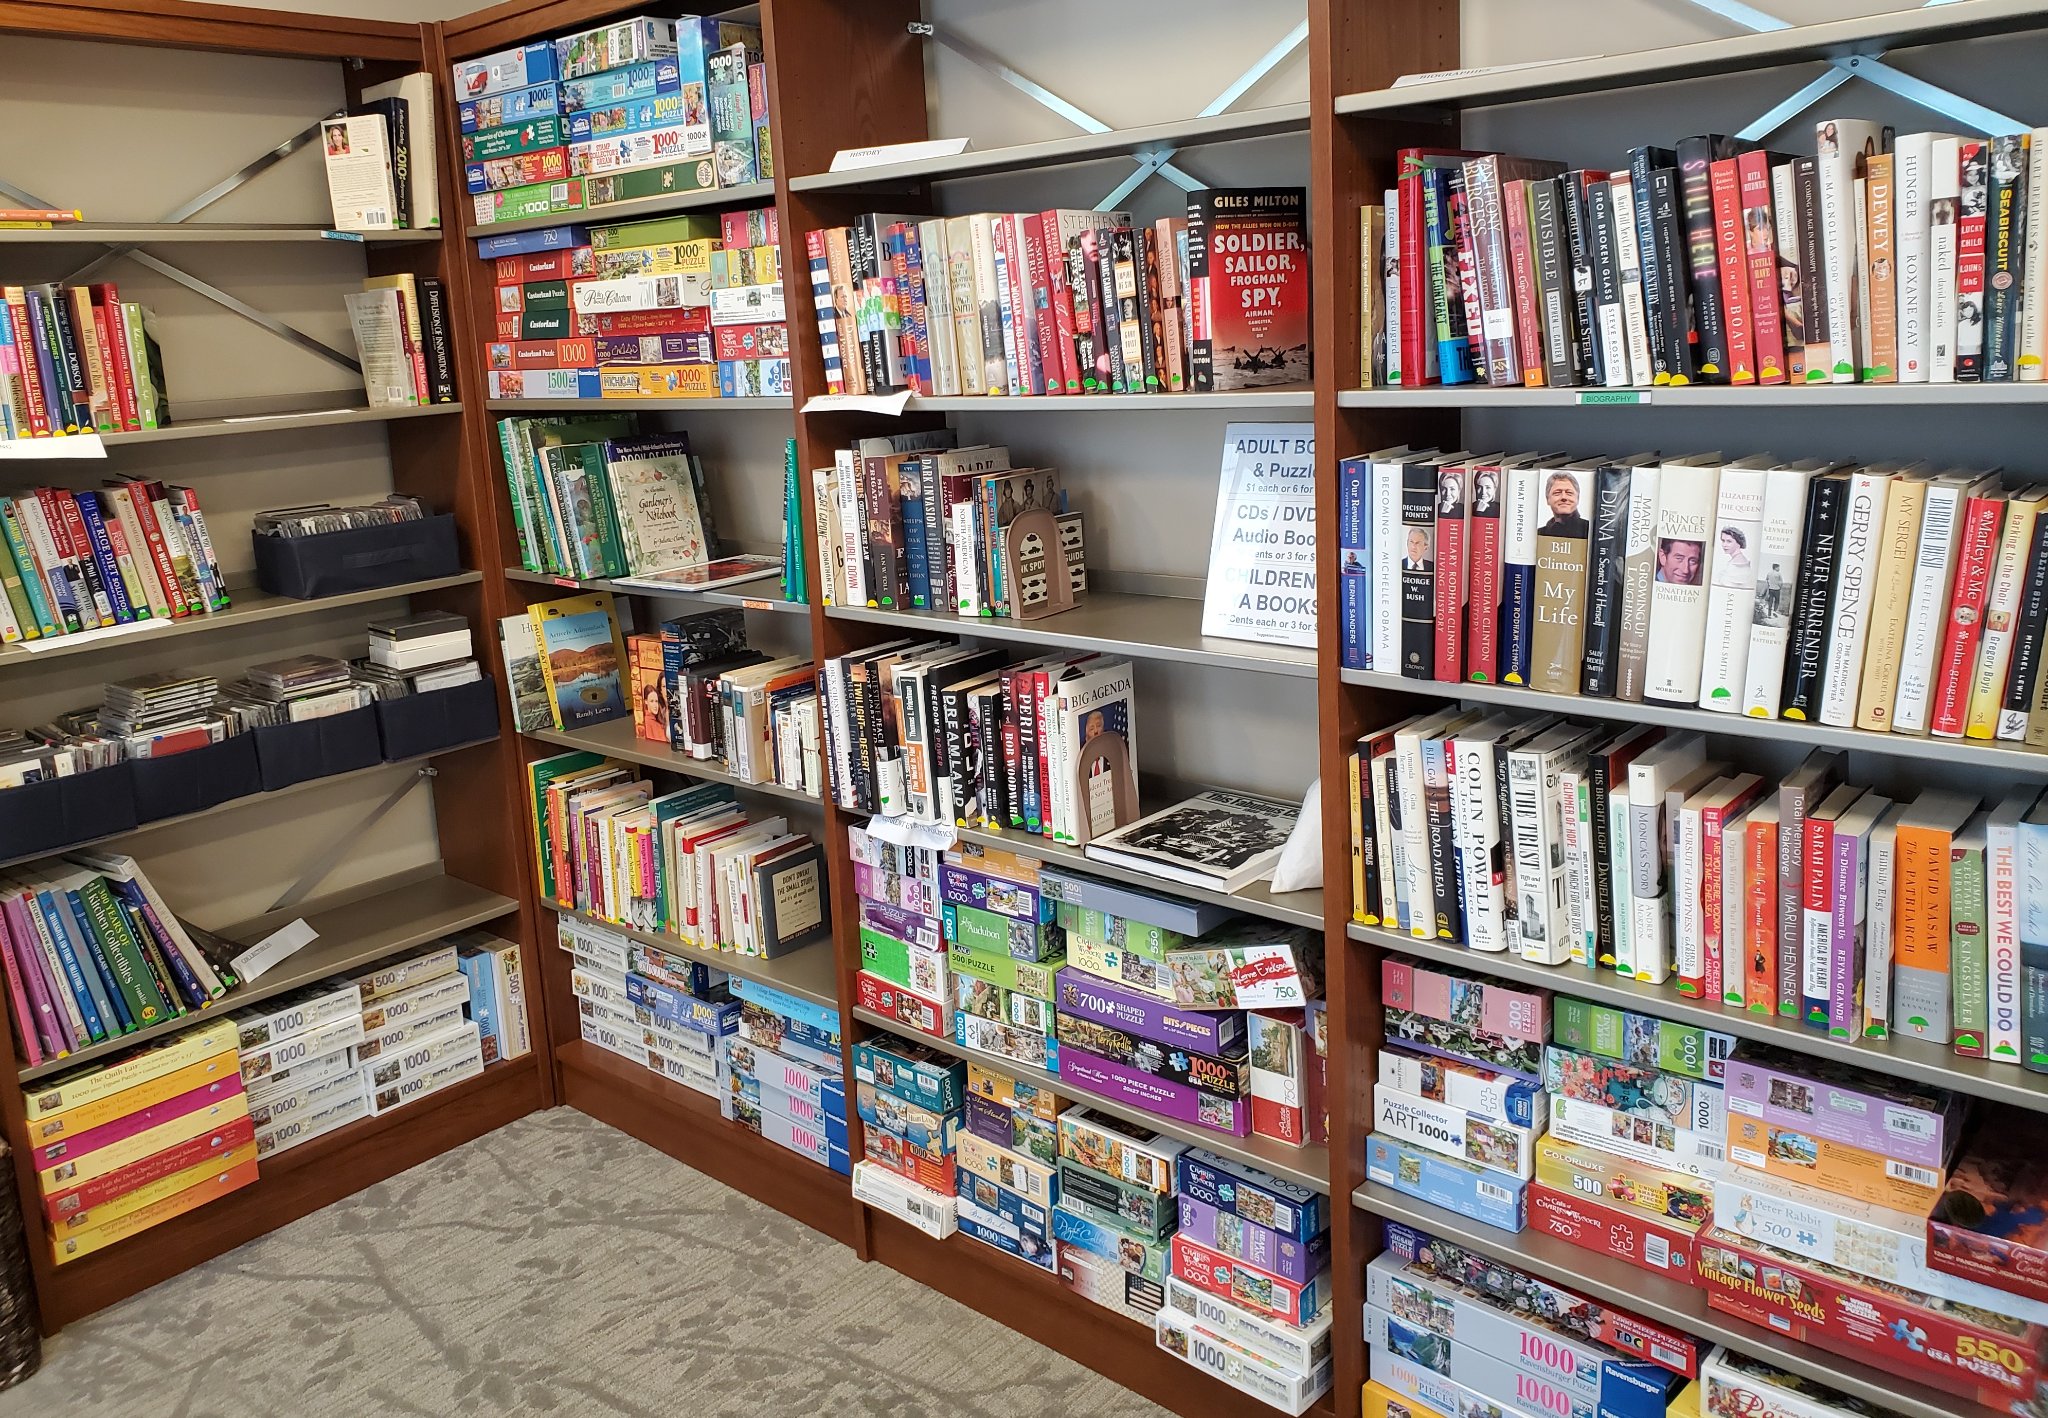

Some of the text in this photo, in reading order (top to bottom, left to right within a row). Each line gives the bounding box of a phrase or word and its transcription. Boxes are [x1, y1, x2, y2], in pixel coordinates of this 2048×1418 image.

[709, 55, 732, 69] 1000
[652, 131, 678, 154] 1000
[661, 144, 685, 154] PUZZLE
[849, 149, 882, 158] HISTORY
[1906, 155, 1917, 219] HUNGER
[1214, 195, 1299, 207] GILES MILTON
[1388, 207, 1396, 250] freedom
[1872, 184, 1889, 253] DEWEY
[1538, 191, 1557, 281] INVISIBLE
[1997, 189, 2012, 271] SEABISCUIT
[1214, 232, 1305, 253] SOLDIER,
[674, 244, 699, 264] 1000
[1938, 236, 1951, 271] naked
[498, 261, 516, 278] 1000
[1225, 254, 1296, 274] SAILOR,
[1231, 273, 1288, 286] FROGMAN,
[1241, 288, 1282, 308] SPY,
[562, 344, 586, 362] 1000
[68, 352, 83, 388] DOBSON
[548, 372, 568, 388] 1500
[677, 369, 701, 388] 1000
[1235, 439, 1289, 454] ADULT
[1253, 463, 1315, 478] & Puzzl
[921, 459, 938, 529] DARK INVASION
[1258, 484, 1278, 492] each
[1300, 485, 1313, 493] for
[1237, 505, 1269, 519] CDs
[1403, 504, 1432, 512] DECISION
[1405, 511, 1428, 519] POINTS
[1600, 490, 1618, 541] DIANA
[1661, 509, 1706, 526] PRINCE
[1233, 528, 1278, 544] Audio
[1665, 523, 1705, 536] WALES
[97, 528, 111, 552] RICE
[105, 554, 118, 575] DIET
[1065, 551, 1084, 562] GUIDE
[1275, 552, 1285, 560] or
[1287, 552, 1293, 560] 3
[1295, 552, 1307, 560] for
[1551, 541, 1572, 554] Bill
[1381, 476, 1390, 650] BECOMING MICHELLE OBAMA
[1537, 558, 1583, 572] Clinton
[1838, 495, 1872, 639] GERRY SPENCE
[1403, 577, 1430, 585] GEORGE
[1544, 582, 1575, 600] My
[1655, 585, 1700, 597] JONATHAN
[1406, 593, 1424, 601] BUSH
[1446, 523, 1458, 662] HILLARY RODHAM CLINTON
[1657, 594, 1699, 604] DIMBLEBY
[1538, 606, 1578, 625] Life
[1802, 533, 1833, 678] NEVER SURRENDER
[1256, 618, 1277, 627] each
[1279, 620, 1288, 628] or
[1291, 621, 1296, 629] 3
[1299, 621, 1311, 631] for
[1002, 677, 1012, 711] FEAR
[1071, 678, 1131, 708] BIG AGENDA
[576, 705, 612, 719] Randy Lewis
[1019, 693, 1033, 746] PERIL
[859, 738, 869, 772] DESERT
[942, 695, 964, 807] DREAMLAND
[1468, 752, 1490, 918] COLIN POWELL
[1514, 790, 1542, 871] THE TRUST
[1637, 811, 1651, 893] MONICA'S STORY
[1811, 825, 1825, 909] SARAH PALIN
[1926, 847, 1940, 954] DAVID NASAW
[967, 923, 1000, 940] Audubon
[1996, 846, 2012, 1032] THE BEST WE COULD DO
[951, 953, 995, 973] 500 PUZZLE
[375, 969, 395, 987] 500
[1961, 940, 1972, 1025] KINGSOLVER
[1273, 986, 1293, 999] 750
[385, 1002, 409, 1018] 1000
[1080, 992, 1106, 1014] 700
[1116, 1003, 1145, 1017] SHAPED
[273, 1011, 304, 1033] 1000
[1116, 1012, 1145, 1026] PUZZLE
[599, 1030, 616, 1048] 1000
[275, 1042, 306, 1064] 1000
[403, 1049, 431, 1071] 1000
[666, 1059, 684, 1078] 1000
[1189, 1056, 1226, 1078] 1000
[400, 1078, 423, 1096] 1000
[783, 1066, 809, 1092] 1000
[1111, 1074, 1175, 1098] 1000 PIECE PUZZLE
[1202, 1073, 1235, 1090] PUZZLE
[1383, 1097, 1449, 1125] Puzzle Collector
[1382, 1108, 1449, 1142] ART 1000
[1543, 1148, 1606, 1173] COLORLUXE
[1573, 1174, 1603, 1197] 500
[1754, 1199, 1822, 1227] Peter Rabbit
[976, 1225, 998, 1243] 1000
[1762, 1220, 1792, 1239] 500
[1696, 1260, 1826, 1321] Vintage Flower Seeds
[1199, 1300, 1226, 1324] 1000
[1193, 1340, 1225, 1371] 1000
[1519, 1331, 1575, 1374] 1000
[1955, 1336, 2025, 1374] 550
[1606, 1365, 1660, 1395] Ravensburger
